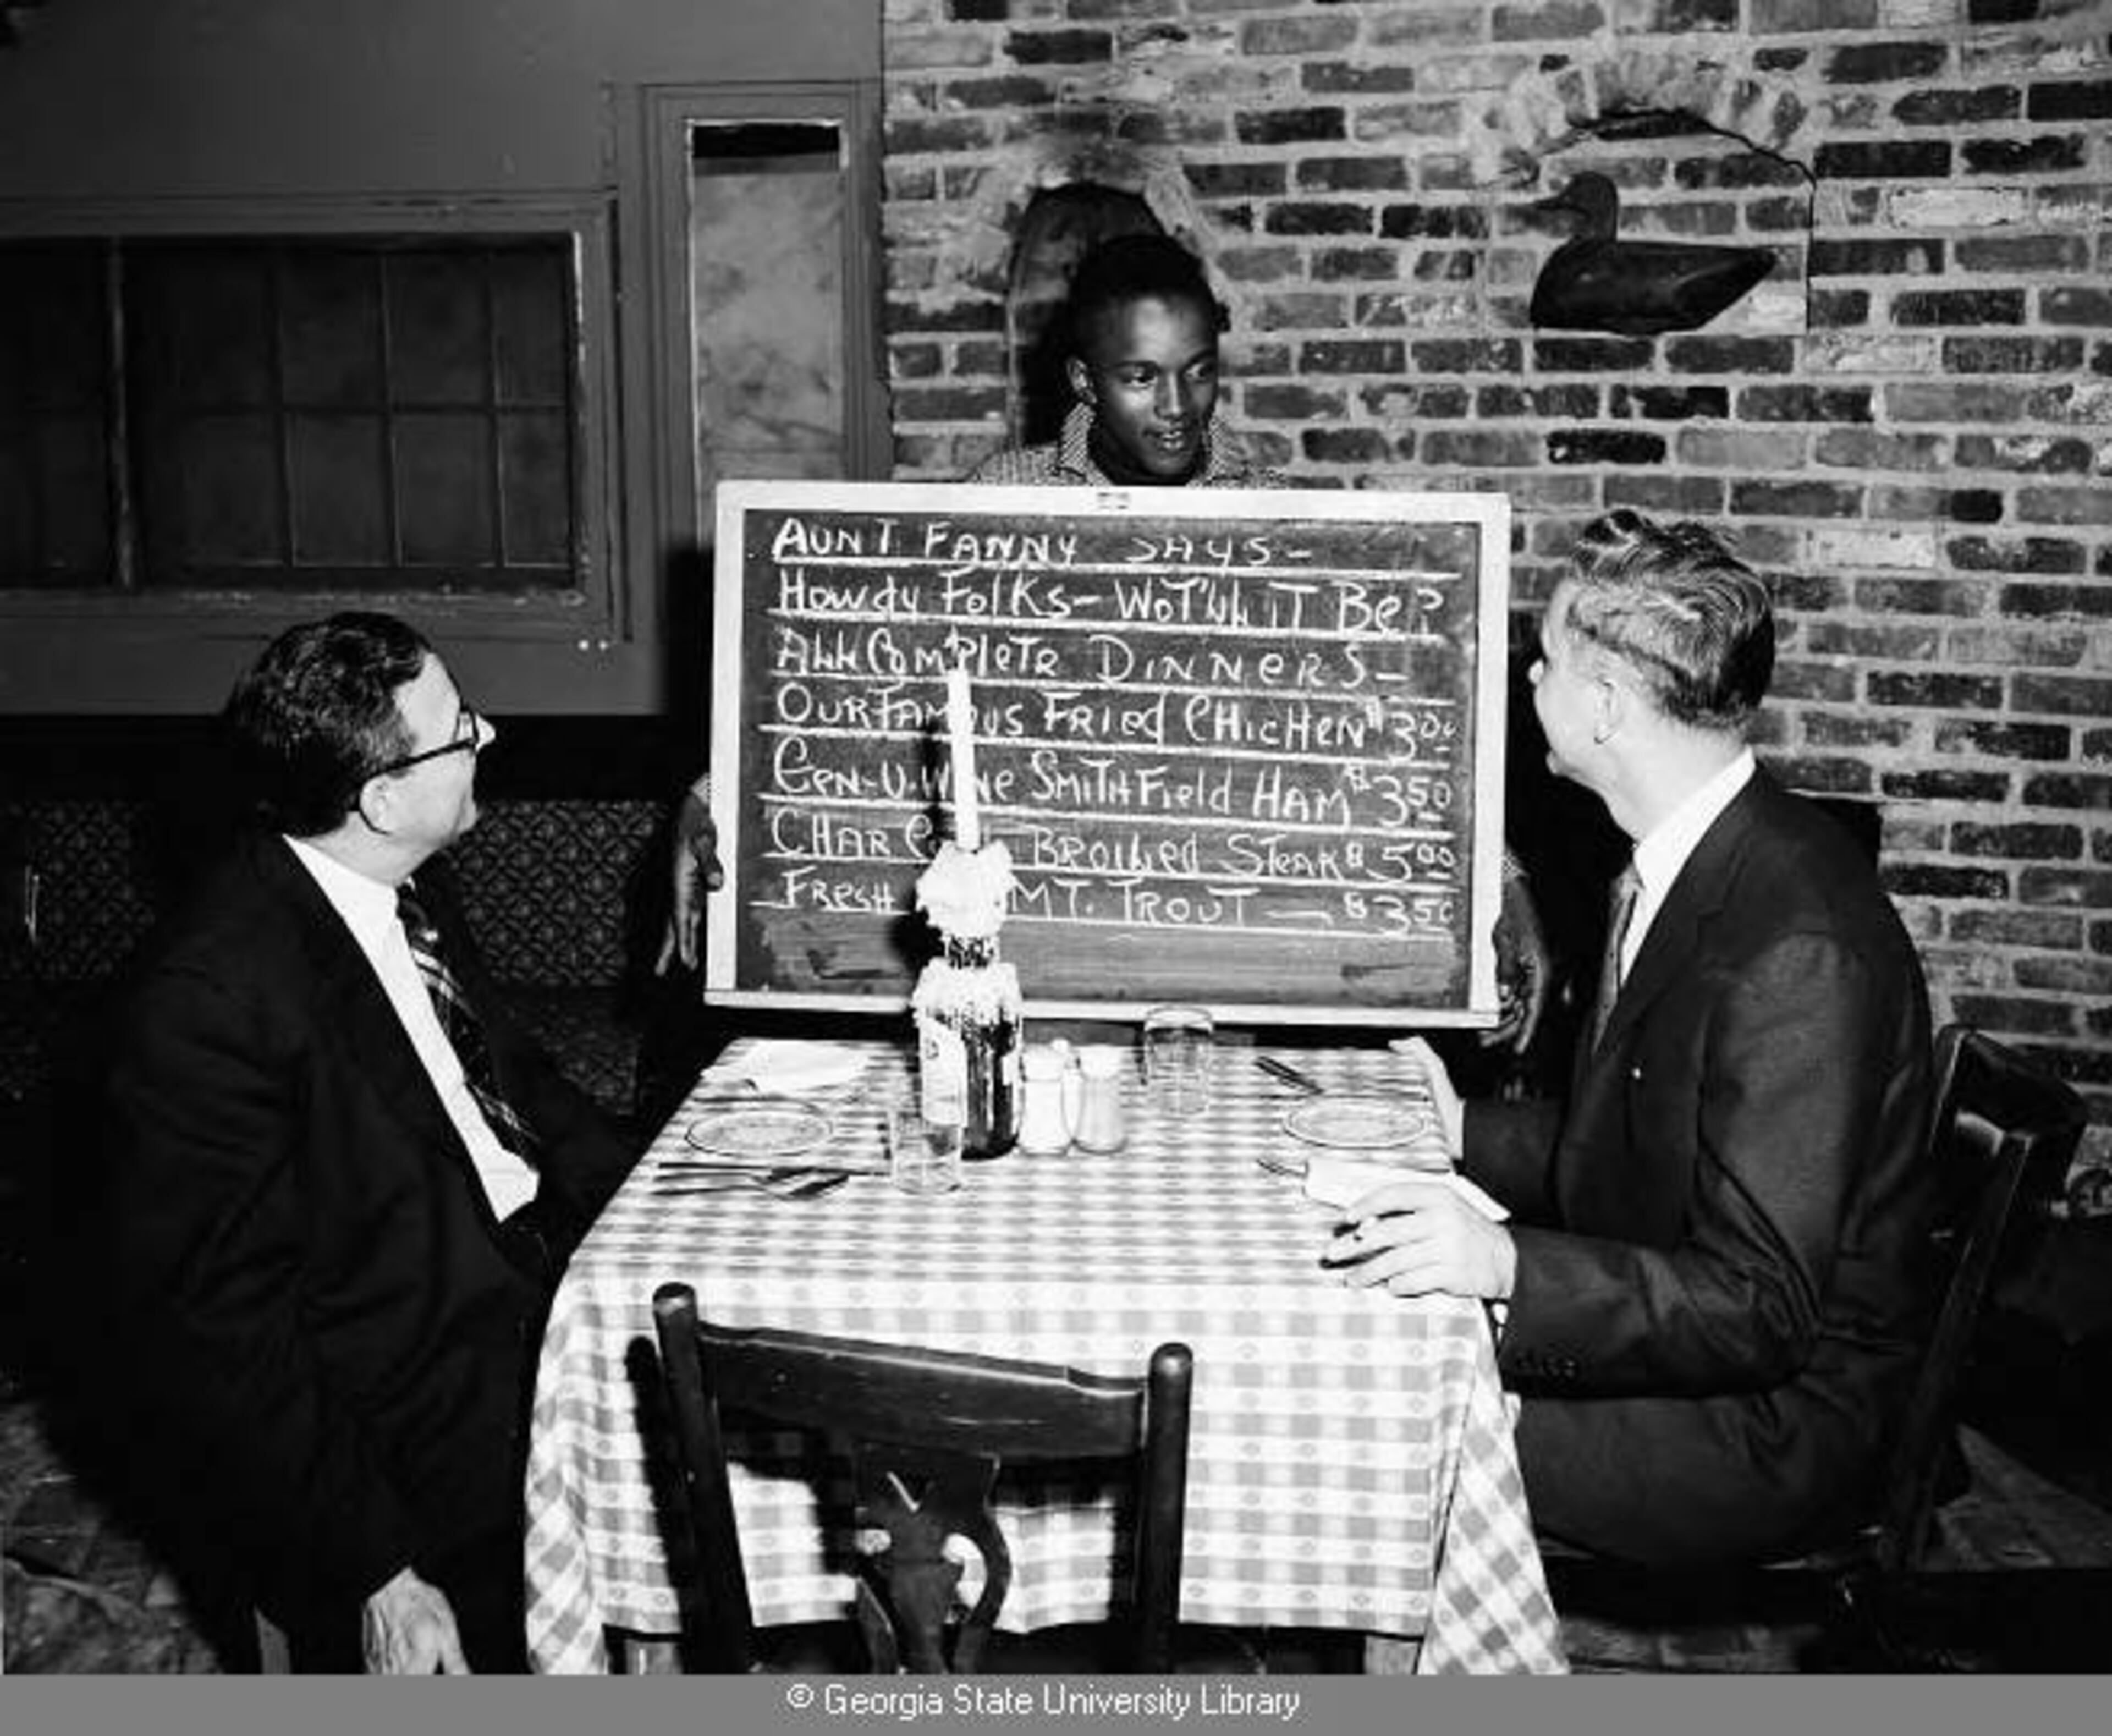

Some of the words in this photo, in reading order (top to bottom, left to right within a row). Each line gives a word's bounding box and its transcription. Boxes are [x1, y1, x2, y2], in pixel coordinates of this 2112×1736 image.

[772, 517, 899, 556] AUNT
[926, 521, 1077, 565] FANNY
[779, 567, 920, 620] Howdy
[1253, 765, 1351, 826] HAM
[1106, 878, 1260, 926] TROUT
